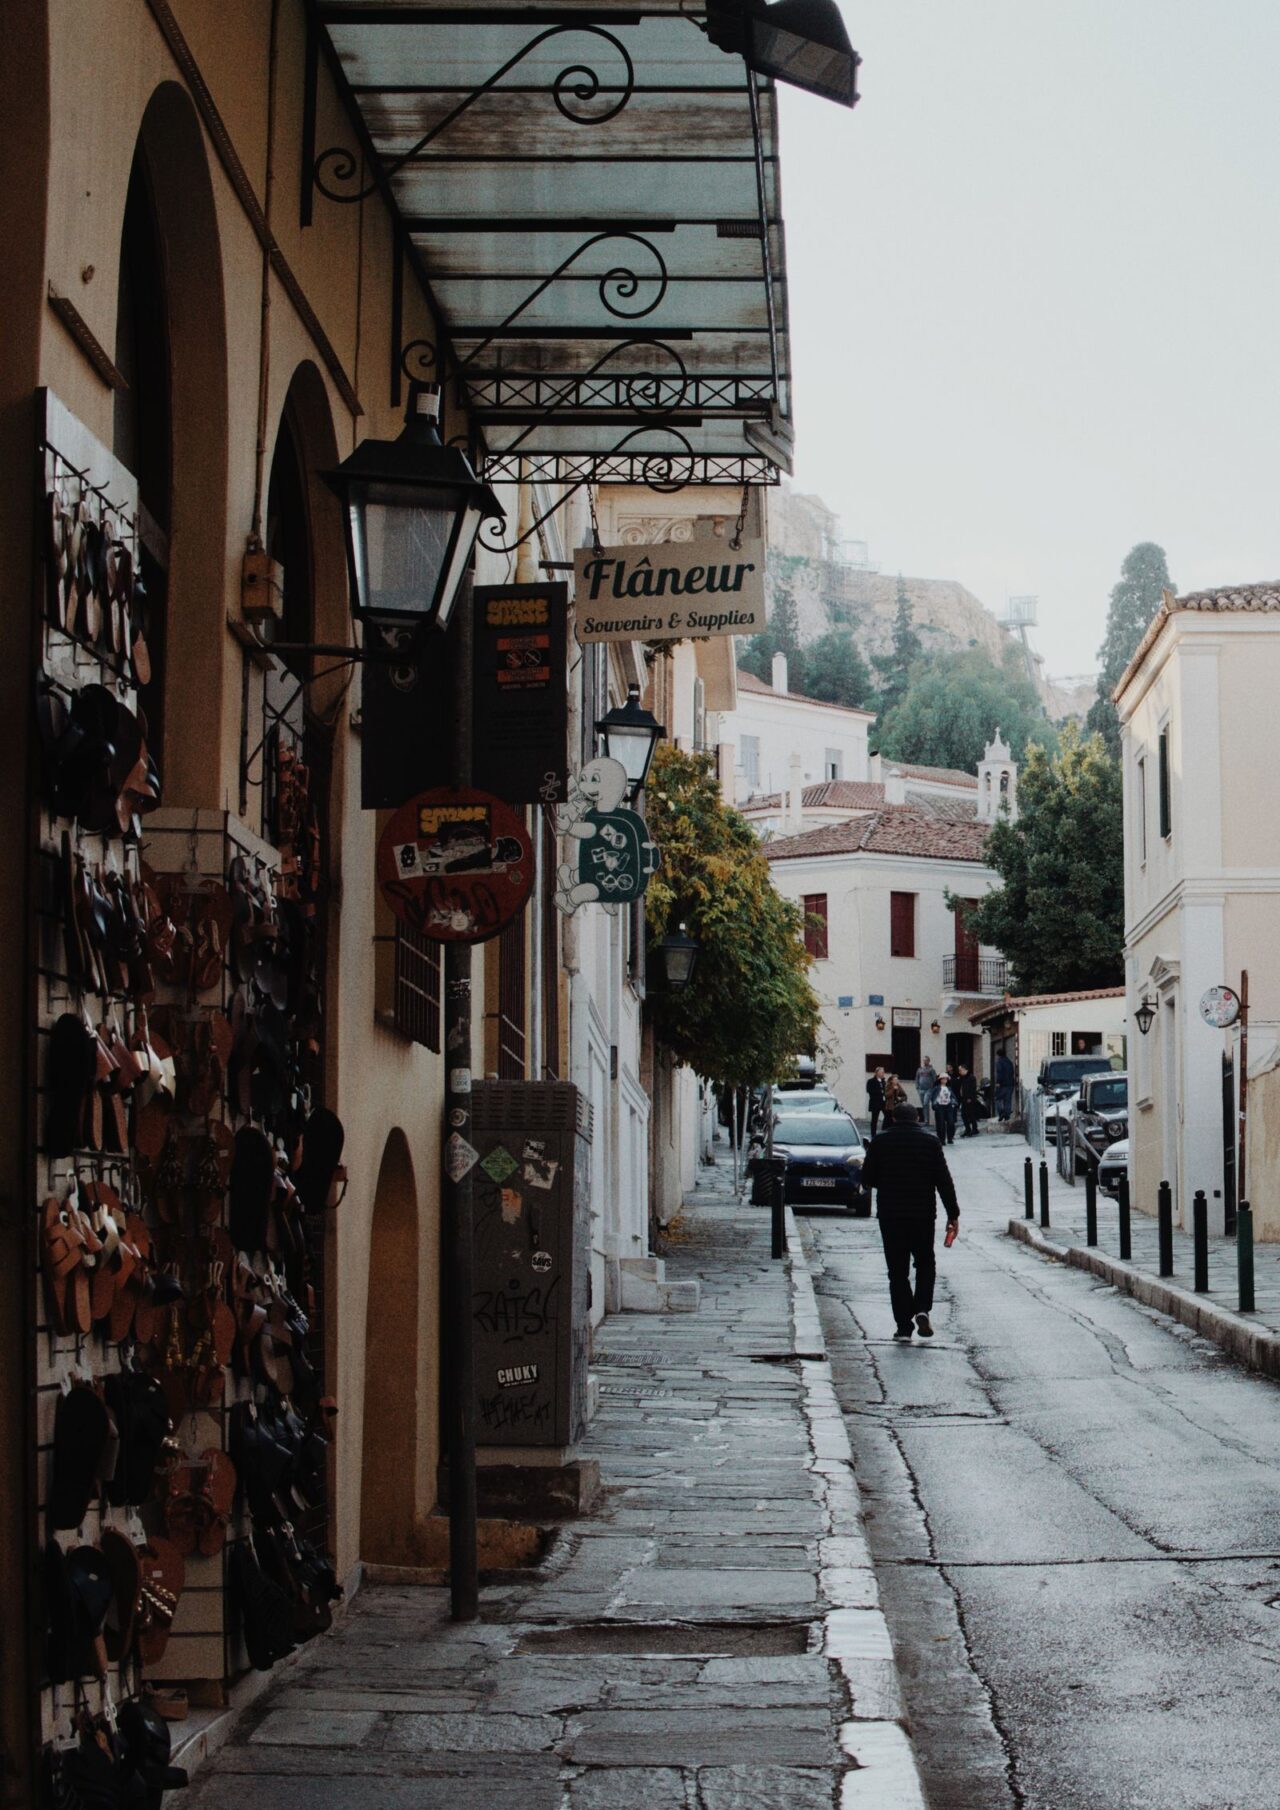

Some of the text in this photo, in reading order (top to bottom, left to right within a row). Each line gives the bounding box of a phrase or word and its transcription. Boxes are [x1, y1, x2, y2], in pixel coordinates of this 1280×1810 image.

[583, 556, 755, 600] Flâneur
[583, 610, 755, 634] Souvenirs & Supplies
[497, 1364, 538, 1384] CHUKY
